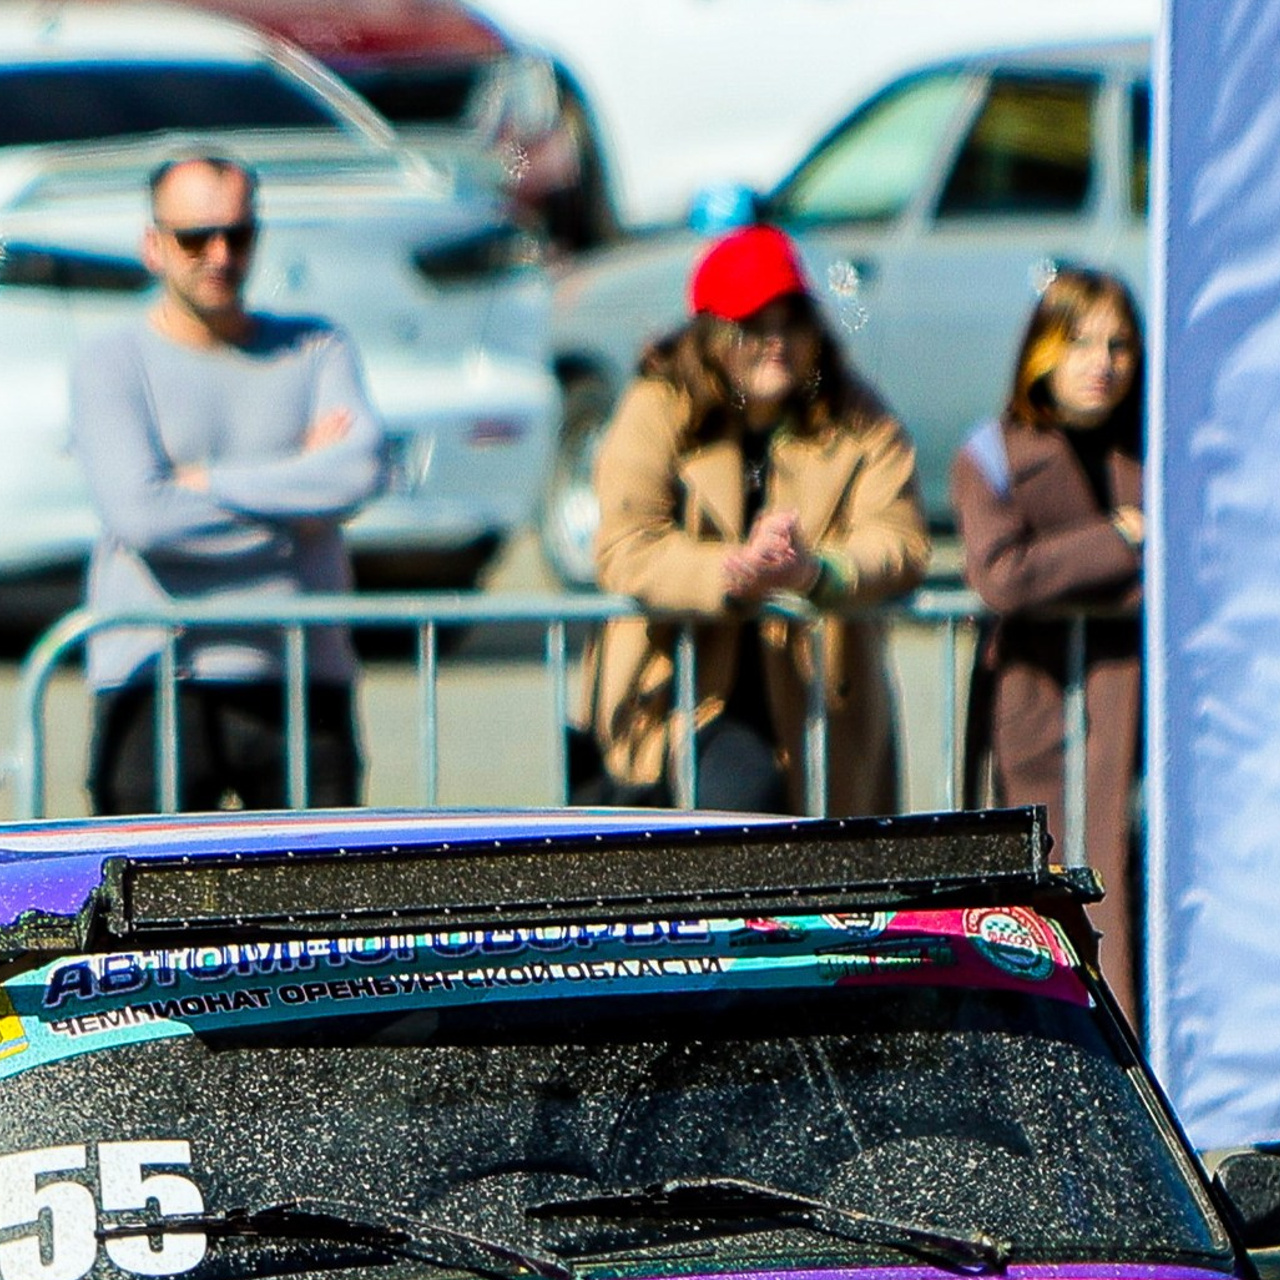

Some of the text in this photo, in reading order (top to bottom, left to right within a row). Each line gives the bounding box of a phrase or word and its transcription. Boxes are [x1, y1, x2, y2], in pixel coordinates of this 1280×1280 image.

[51, 956, 722, 1037] ЧЕМПИОНАТ ОРЕНБУРГСКОЙ ОБЛАСТИ
